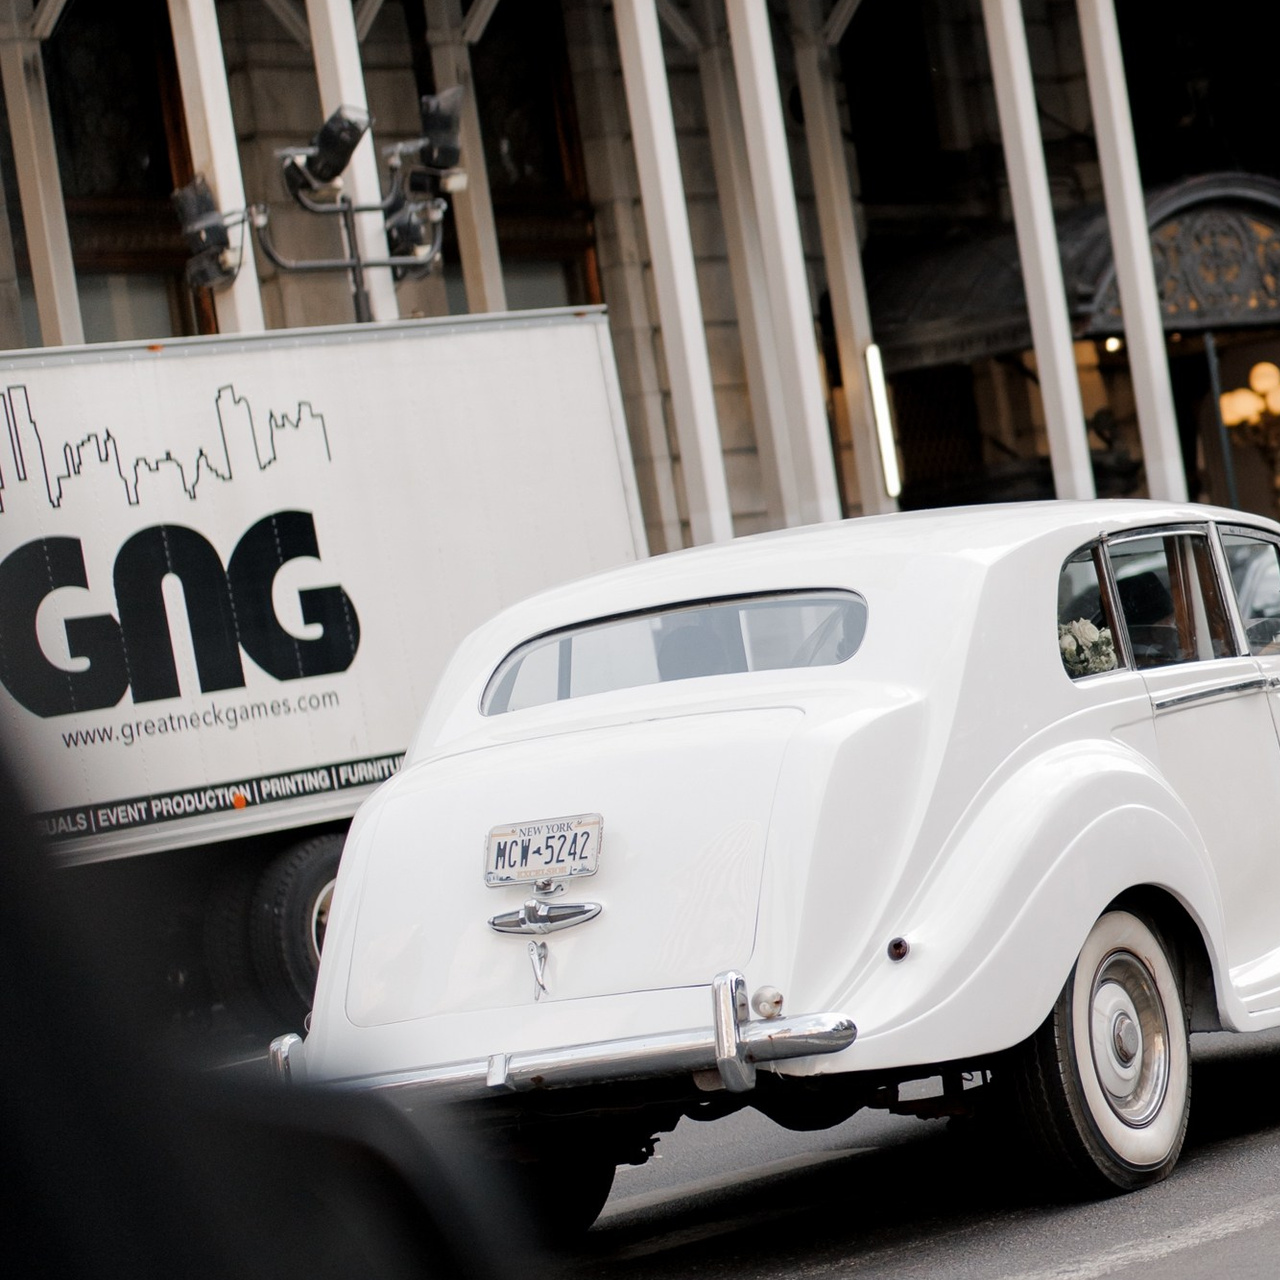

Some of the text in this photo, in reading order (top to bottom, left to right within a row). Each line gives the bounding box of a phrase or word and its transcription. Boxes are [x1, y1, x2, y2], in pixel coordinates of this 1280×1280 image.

[62, 689, 340, 749] www.greatneckgames.com
[98, 801, 149, 829] EVENT
[260, 769, 332, 800] PRINTING
[518, 821, 574, 838] NEW YORK
